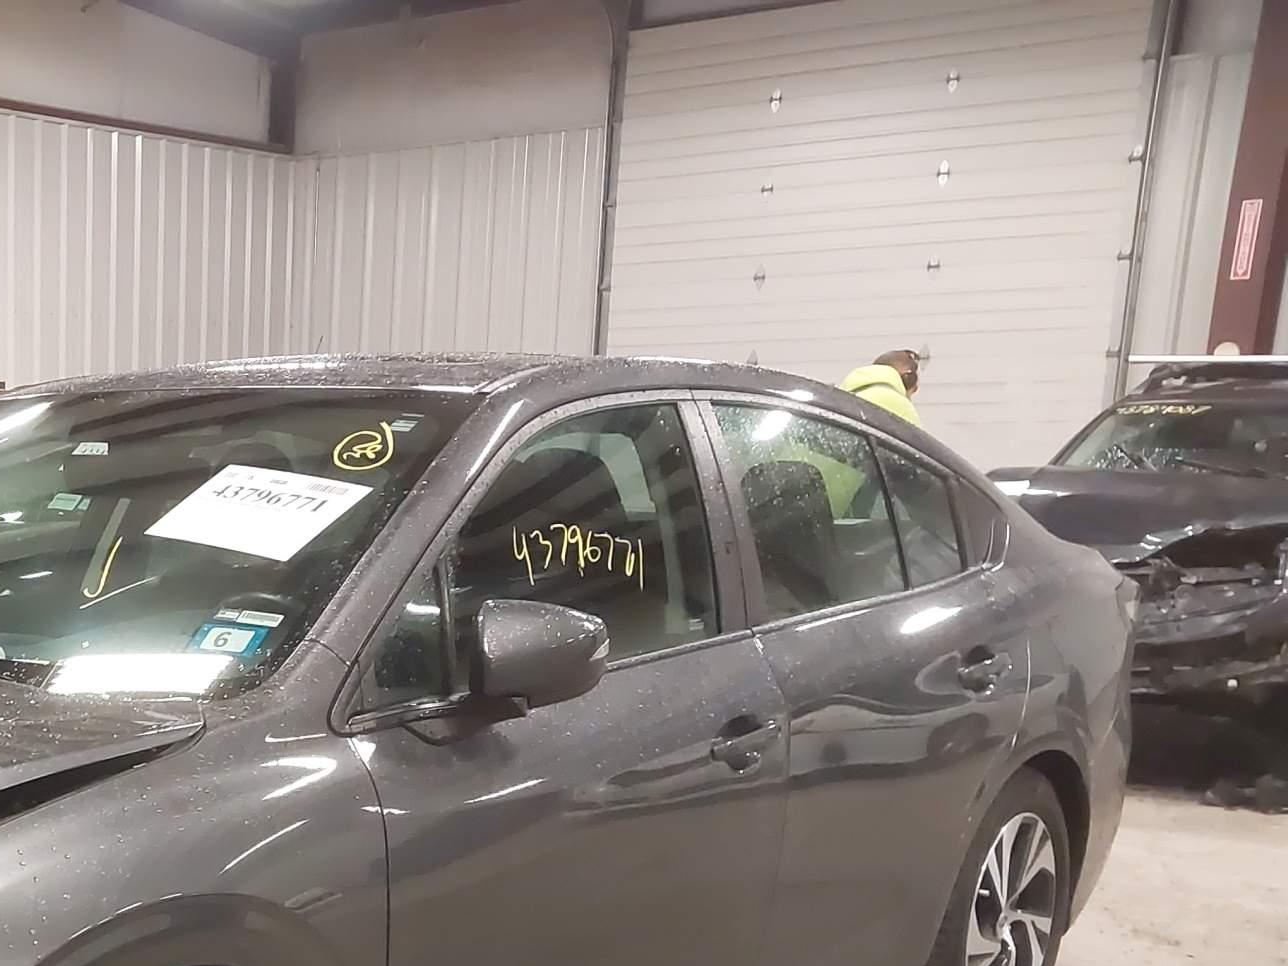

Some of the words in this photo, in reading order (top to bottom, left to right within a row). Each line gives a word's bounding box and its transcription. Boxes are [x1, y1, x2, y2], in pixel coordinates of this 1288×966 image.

[212, 484, 328, 512] 43796771
[513, 523, 644, 592] 43796771
[213, 631, 232, 648] 6
